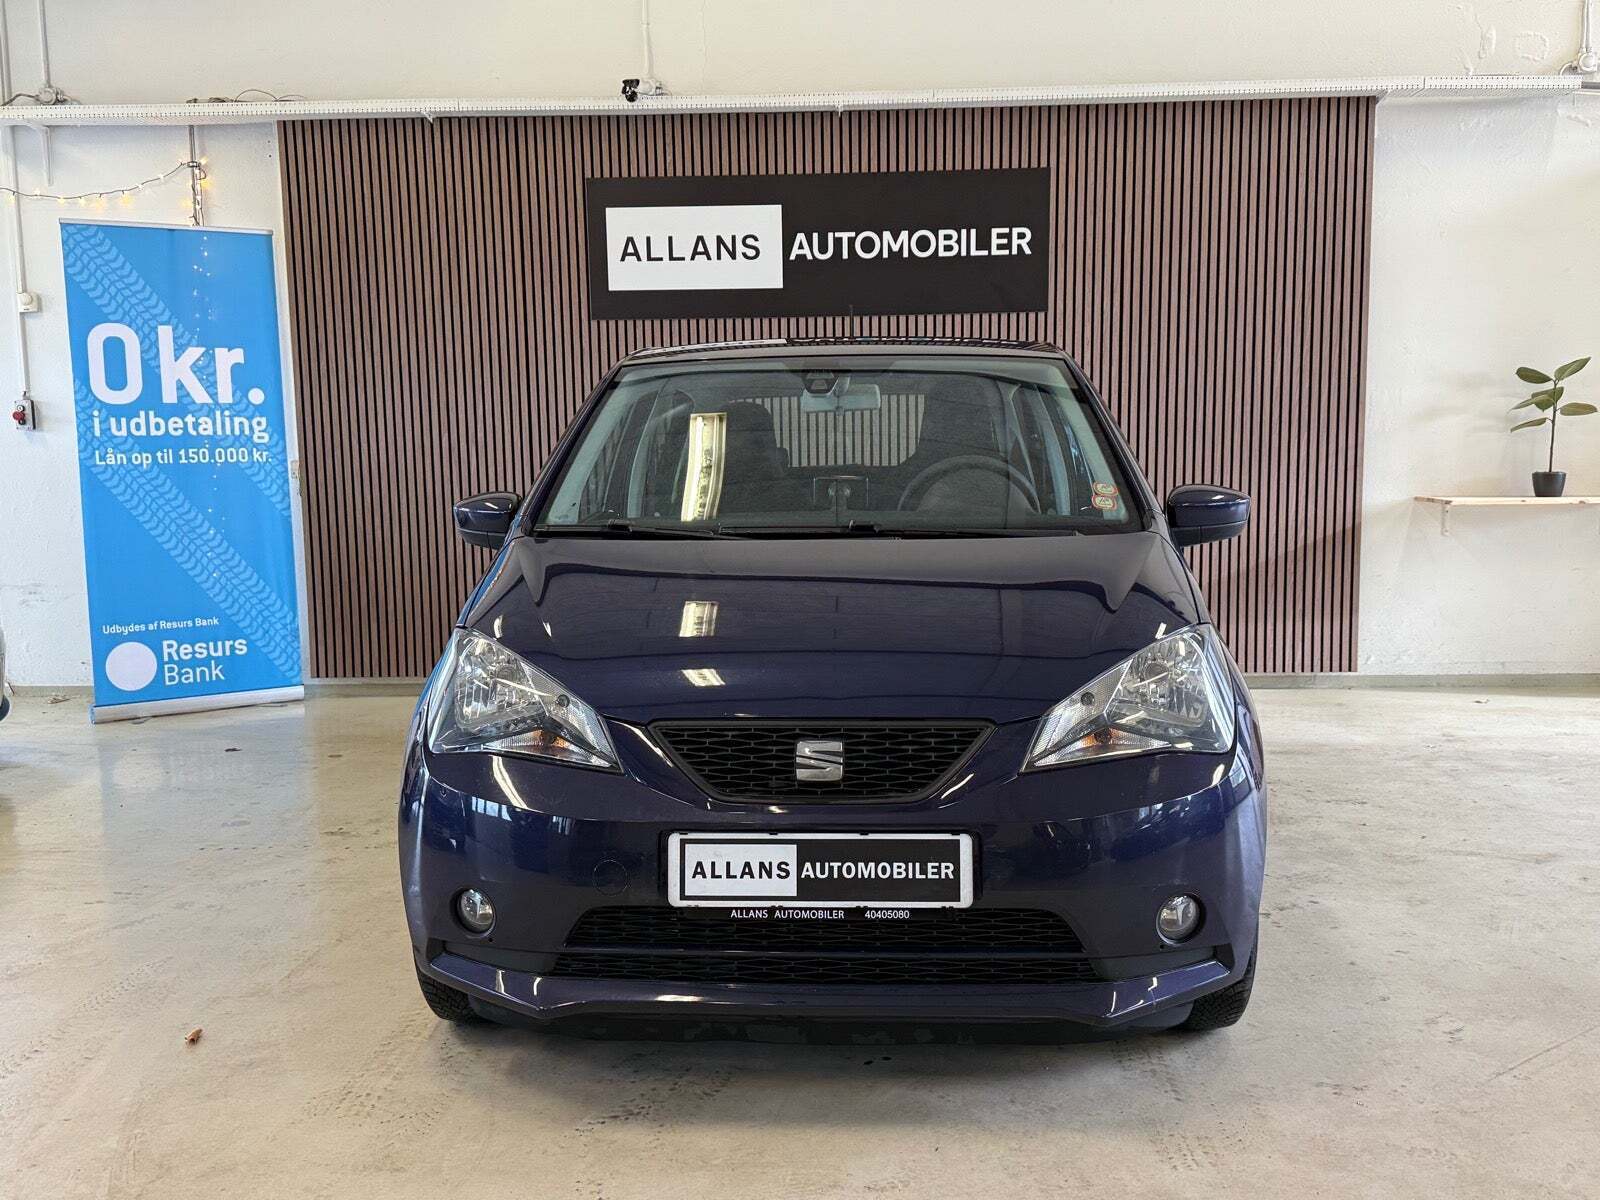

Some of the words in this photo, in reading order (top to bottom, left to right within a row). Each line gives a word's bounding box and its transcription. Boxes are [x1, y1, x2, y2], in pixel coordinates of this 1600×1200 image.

[619, 234, 761, 262] ALLANS
[789, 226, 1033, 261] AUTOMOBILER
[87, 322, 144, 405] 0
[157, 325, 265, 405] kr.
[93, 410, 100, 437] i
[110, 411, 270, 443] udbetaling
[95, 448, 127, 465] Lån
[131, 451, 152, 469] op
[156, 449, 173, 463] til
[179, 448, 249, 463] 150.000
[252, 447, 272, 463] kr.
[102, 624, 146, 635] Udbydes
[148, 622, 158, 631] af
[159, 619, 193, 630] Resurs
[195, 616, 220, 627] Bank
[162, 638, 248, 662] Resurs
[164, 660, 225, 686] Bank
[691, 861, 791, 880] ALLANS
[800, 862, 955, 880] AUTOMOBILER
[730, 909, 768, 919] ALLANS
[774, 910, 844, 920] AUTOMOBILER
[864, 910, 910, 919] 40405080
